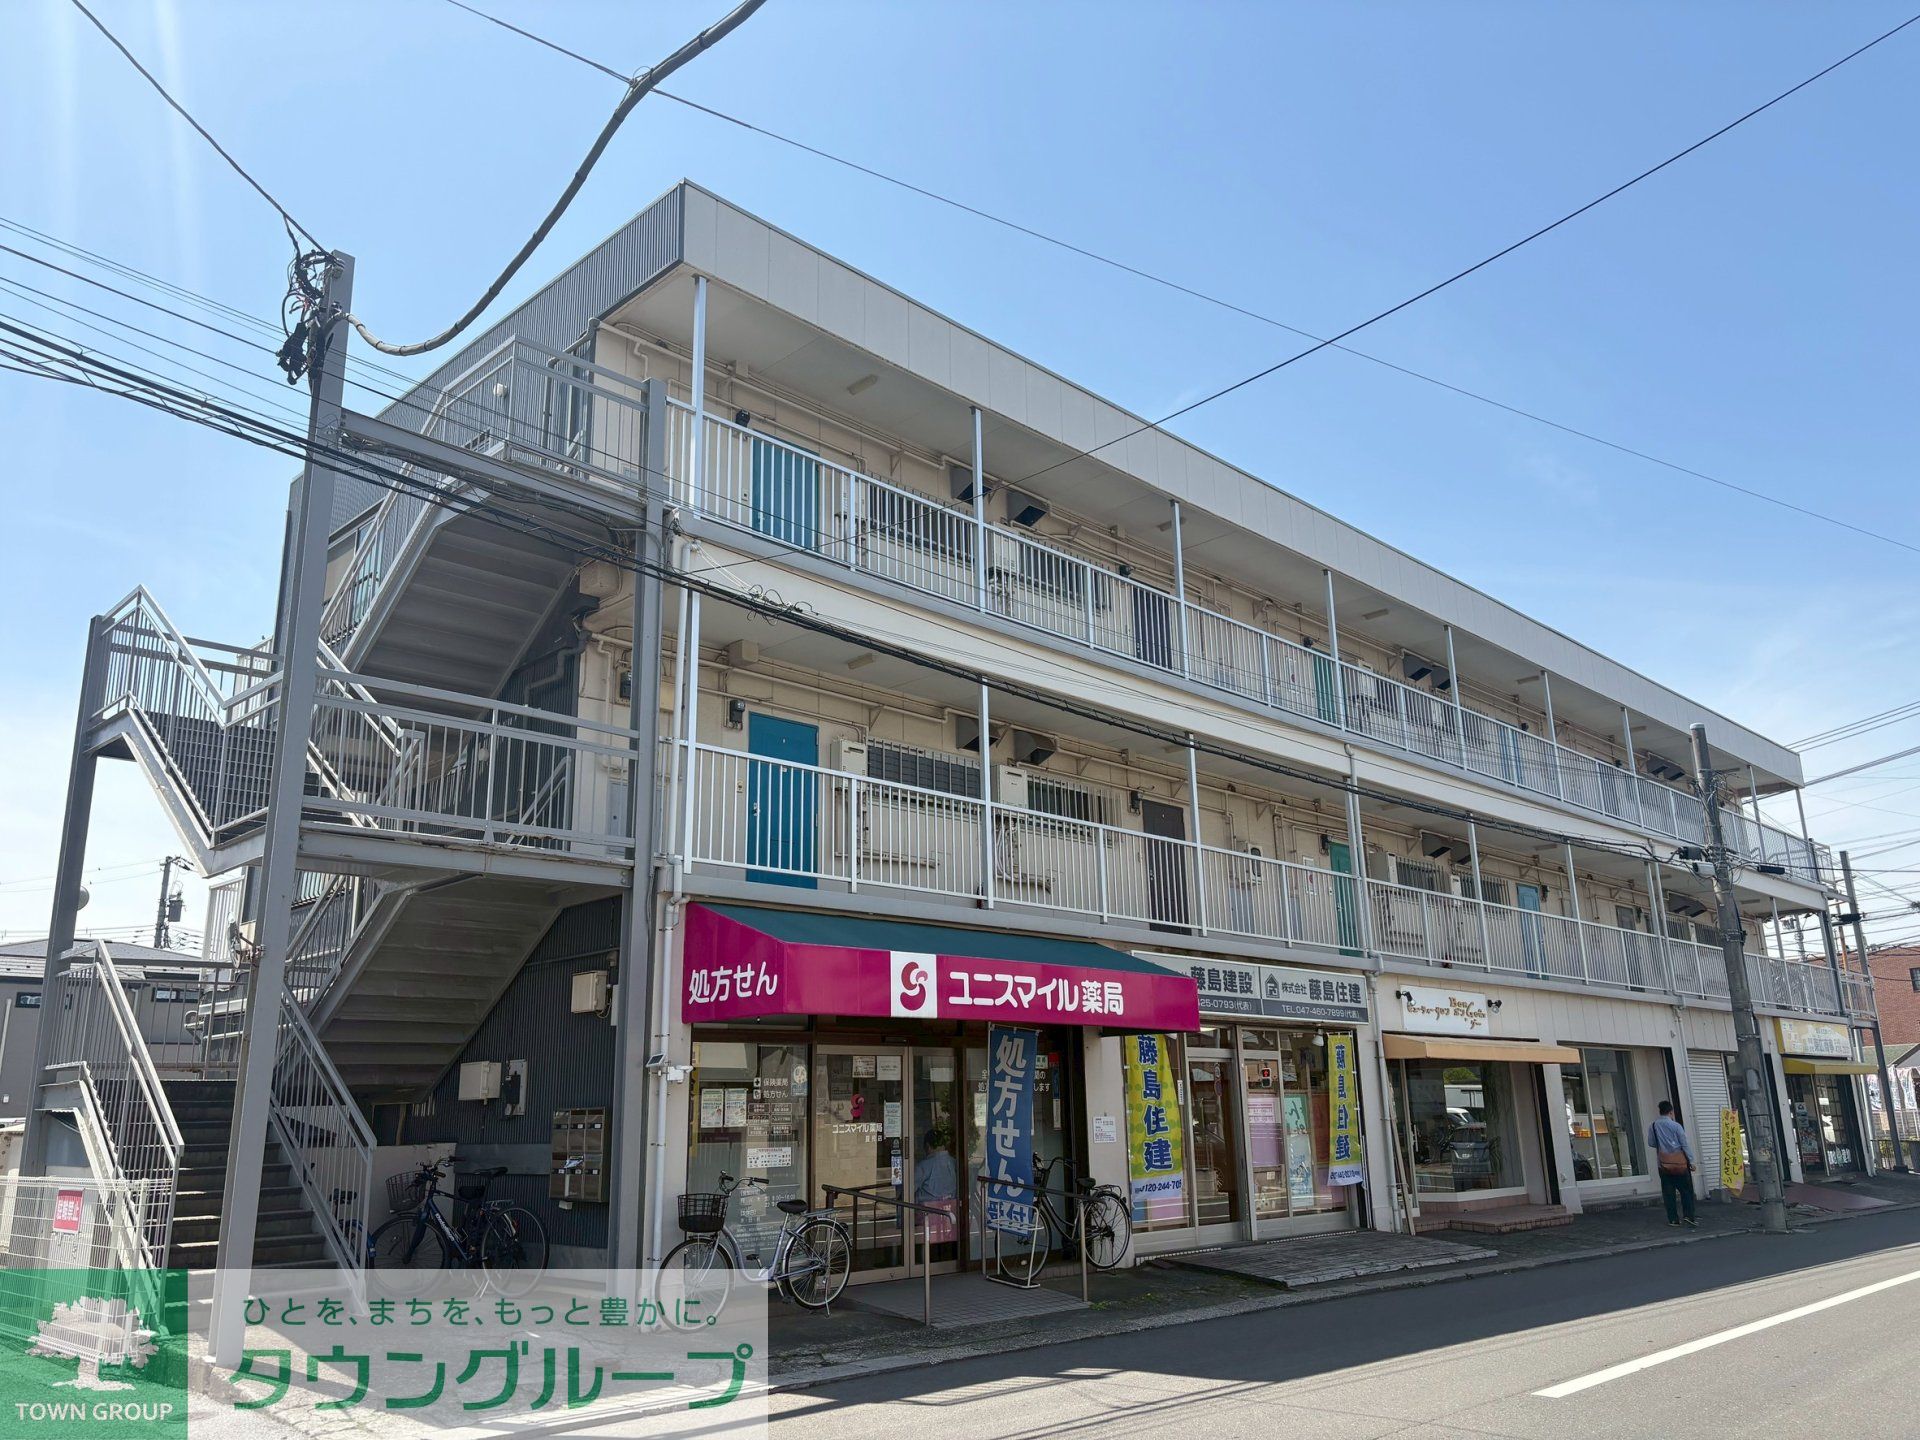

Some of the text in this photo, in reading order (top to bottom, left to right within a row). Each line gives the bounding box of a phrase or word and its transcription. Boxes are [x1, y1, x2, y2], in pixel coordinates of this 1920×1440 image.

[689, 962, 778, 1003] 処方せん
[948, 970, 1124, 1016] ユニスマイル薬局
[1190, 966, 1254, 995] 藤島建設
[1281, 978, 1362, 1004] 株式会社 藤島住建
[1198, 998, 1252, 1012] 25-0793(代表)
[992, 1034, 1027, 1198] 処方せん
[1137, 1034, 1173, 1171] 藤島住建
[832, 1122, 883, 1134] ユニスマイル薬局
